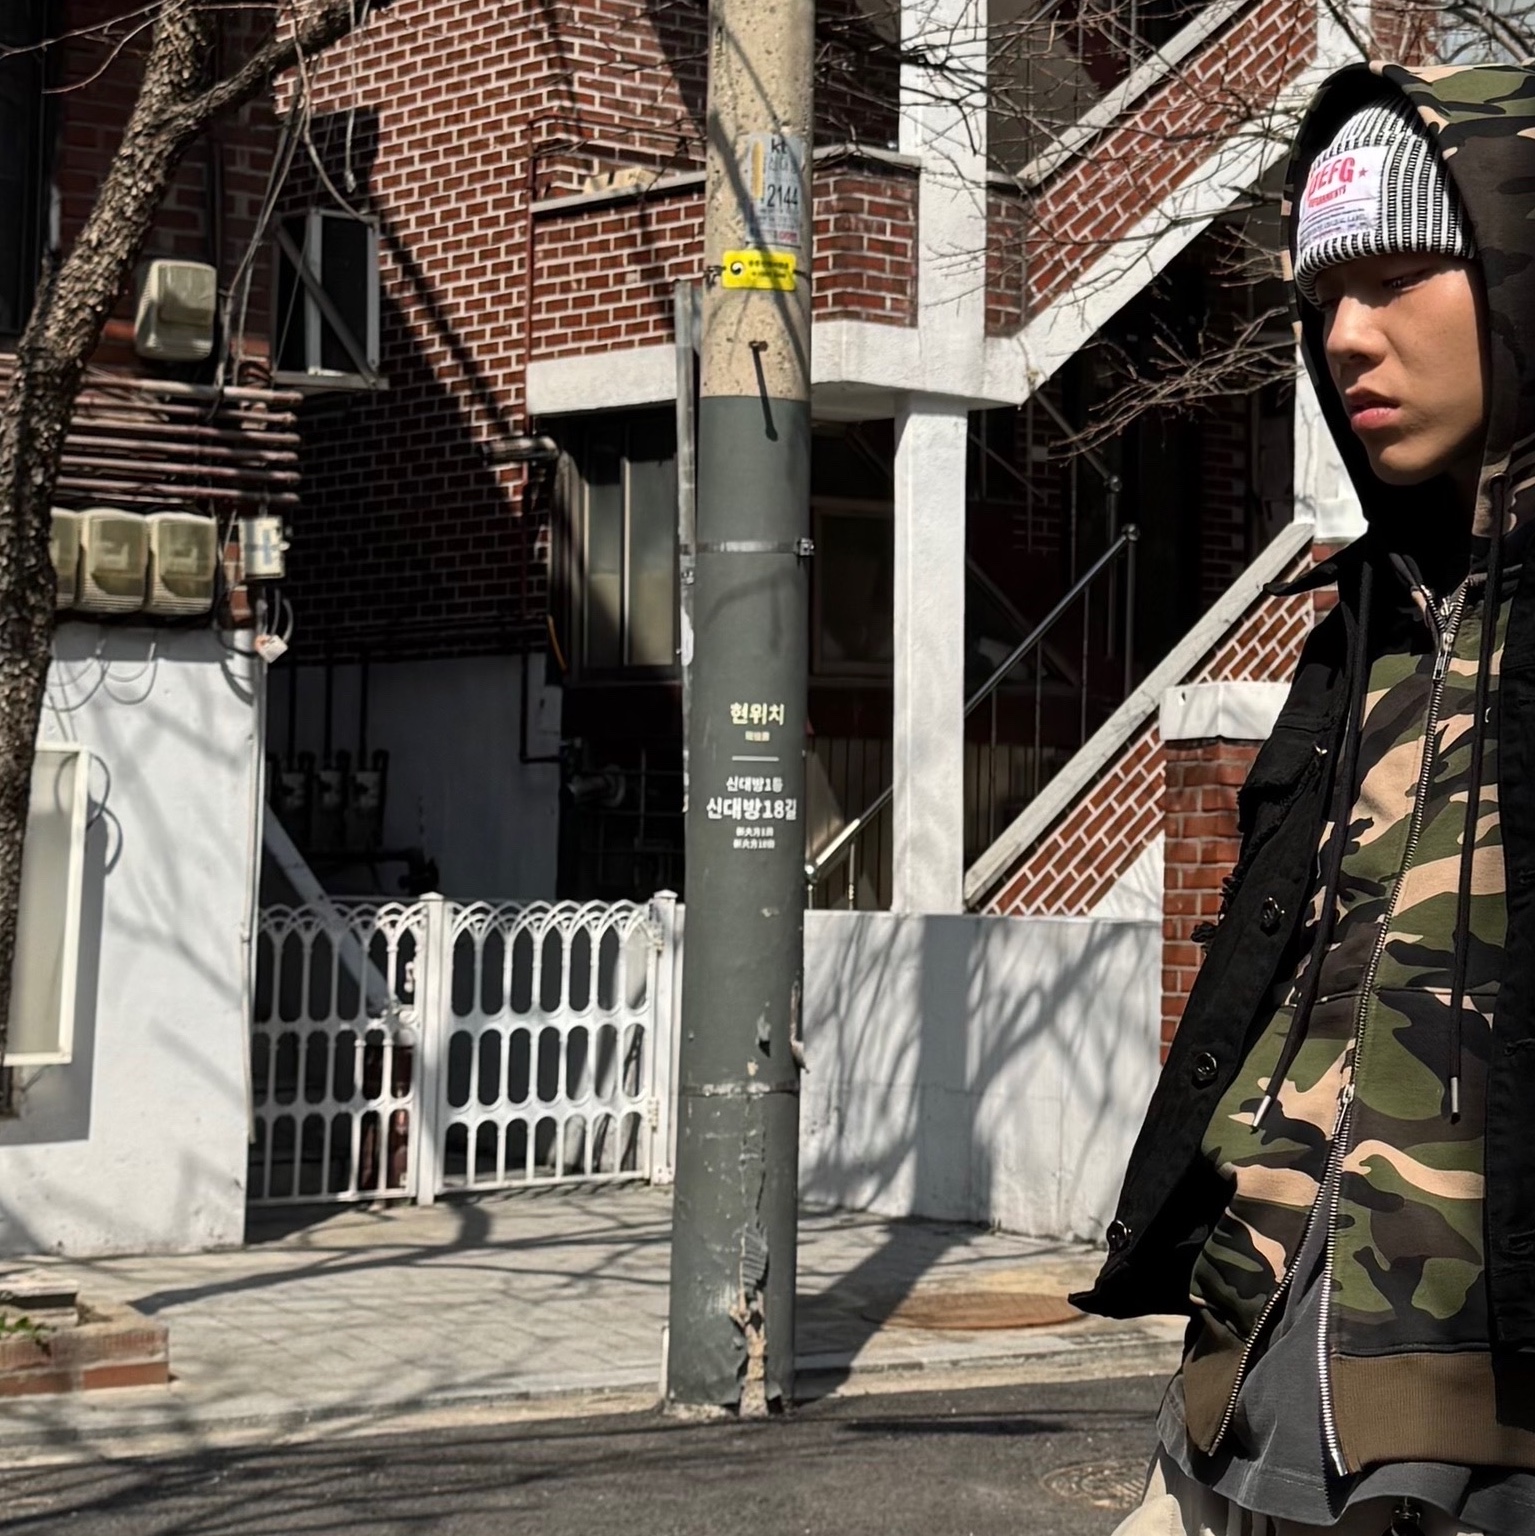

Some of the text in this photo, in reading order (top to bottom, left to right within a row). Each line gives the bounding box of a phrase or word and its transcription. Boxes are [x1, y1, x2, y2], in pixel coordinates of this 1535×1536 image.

[766, 183, 799, 208] 2144
[729, 702, 785, 726] 현위치
[706, 796, 798, 821] 신대방18길
